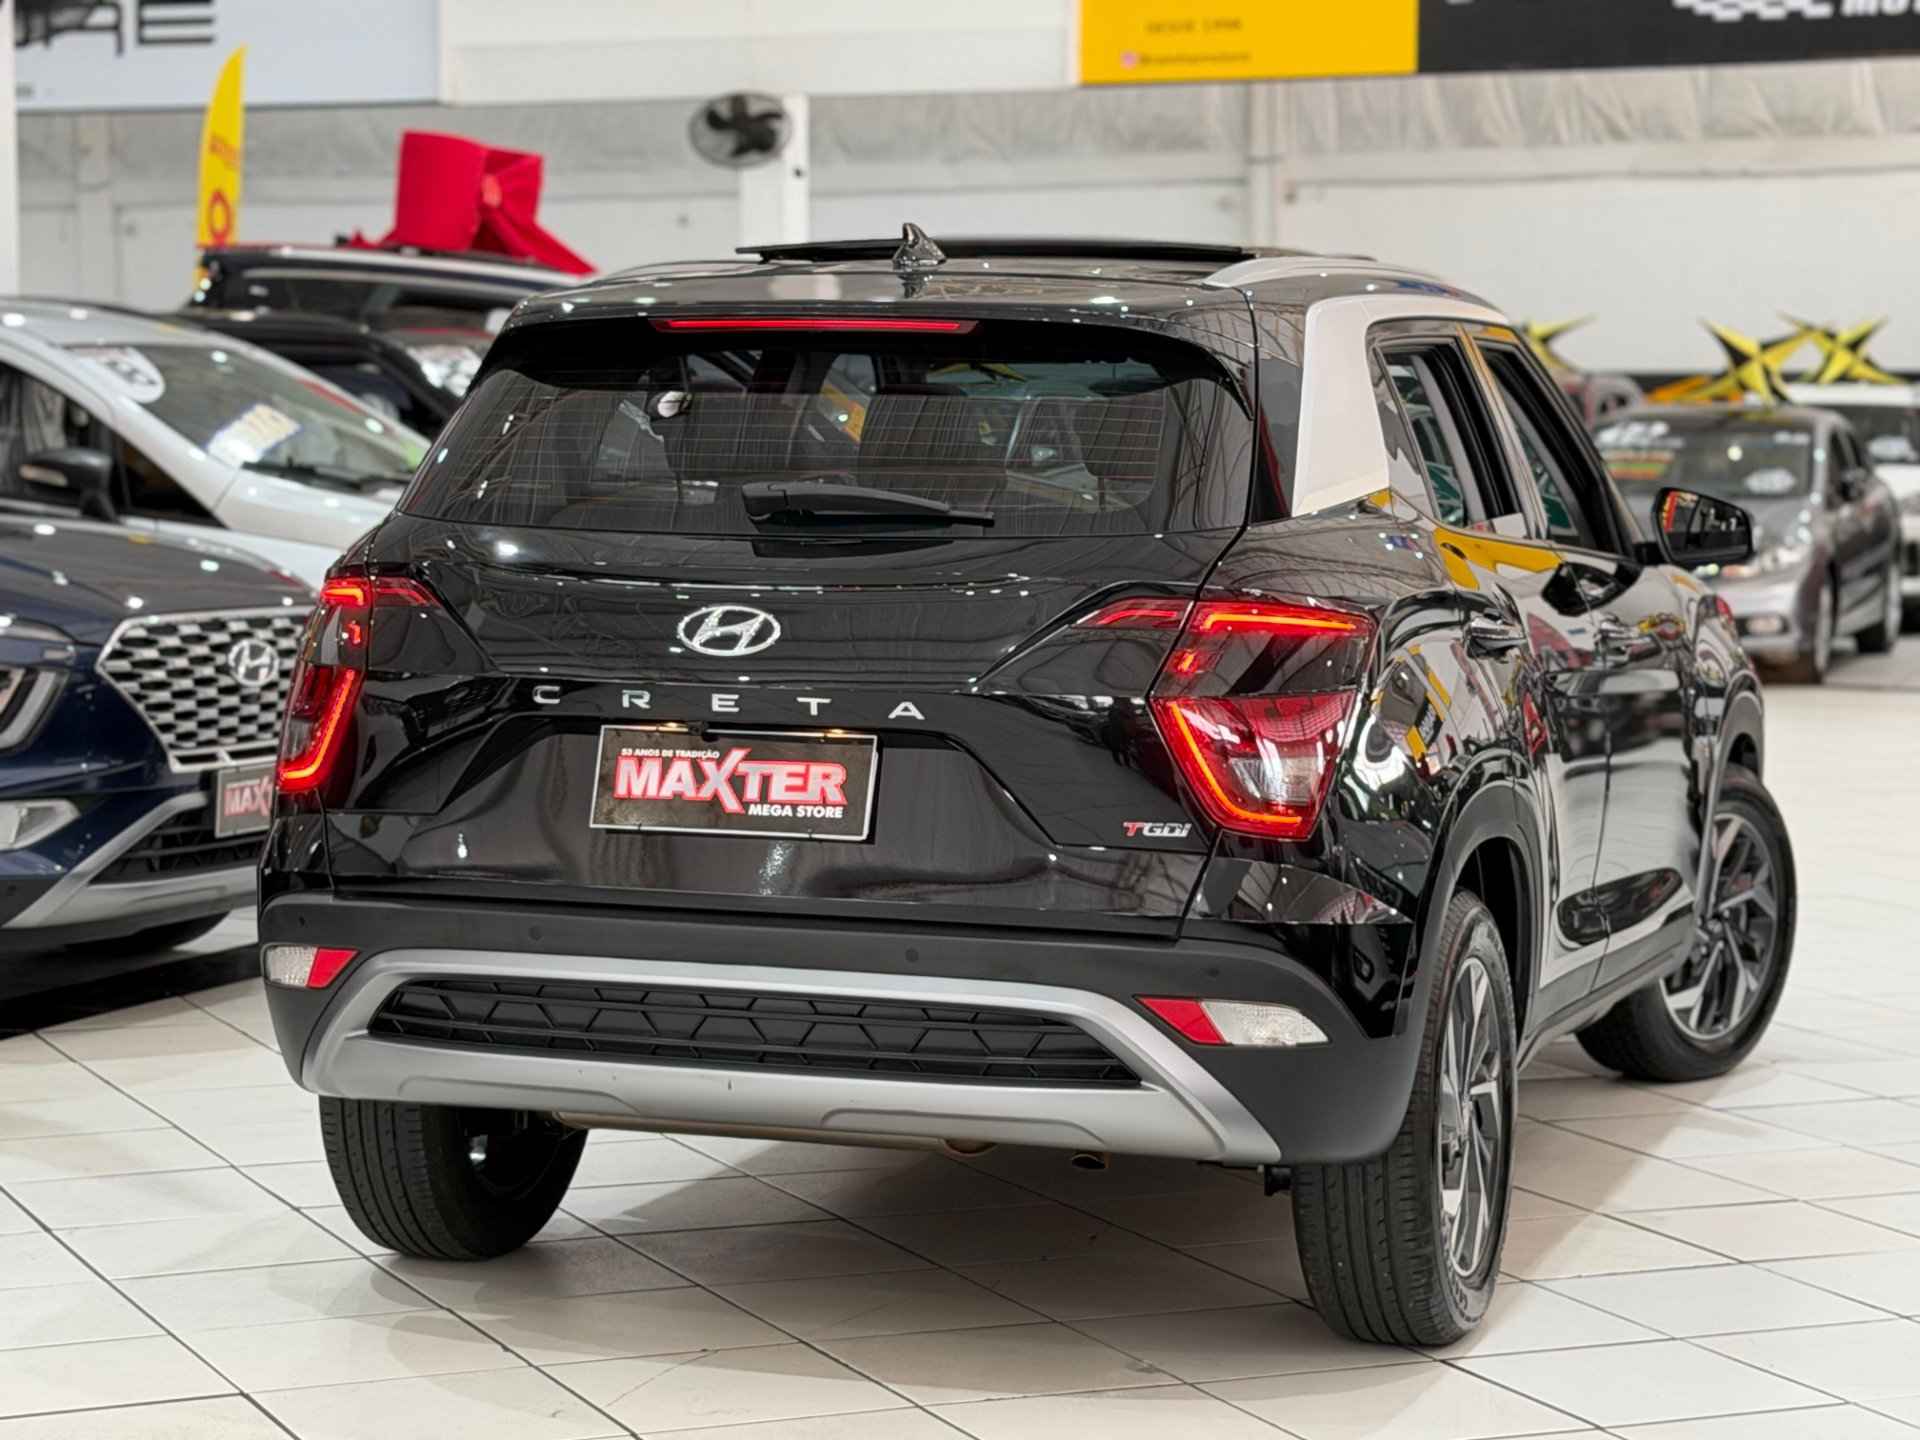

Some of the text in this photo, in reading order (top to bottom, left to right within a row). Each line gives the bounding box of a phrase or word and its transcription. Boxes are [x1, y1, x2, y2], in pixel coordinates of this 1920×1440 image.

[532, 684, 926, 721] CRETA
[634, 748, 660, 757] ANOS
[661, 749, 673, 757] DE
[675, 749, 720, 759] TRADIÇÃO
[614, 747, 848, 813] MAXTER
[748, 803, 844, 819] MEGA STORE
